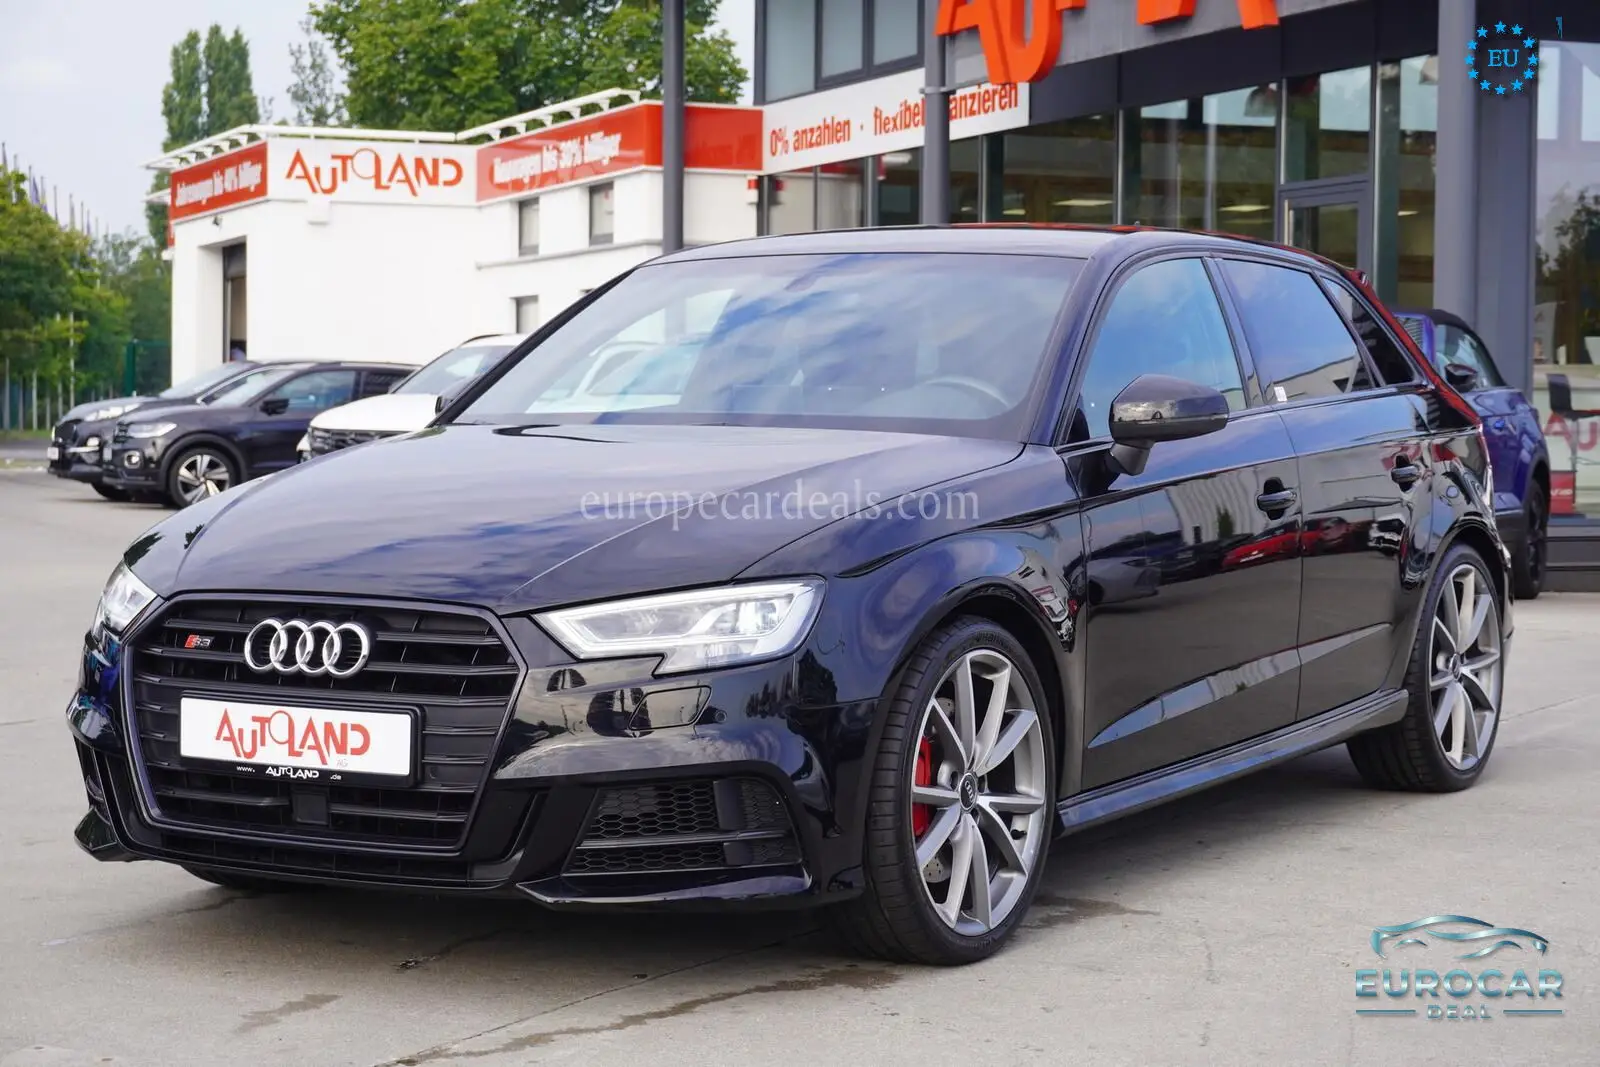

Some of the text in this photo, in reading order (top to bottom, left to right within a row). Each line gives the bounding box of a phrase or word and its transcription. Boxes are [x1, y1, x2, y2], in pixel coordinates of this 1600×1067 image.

[769, 81, 1019, 156] 0% anzahlen flexibel anzieren
